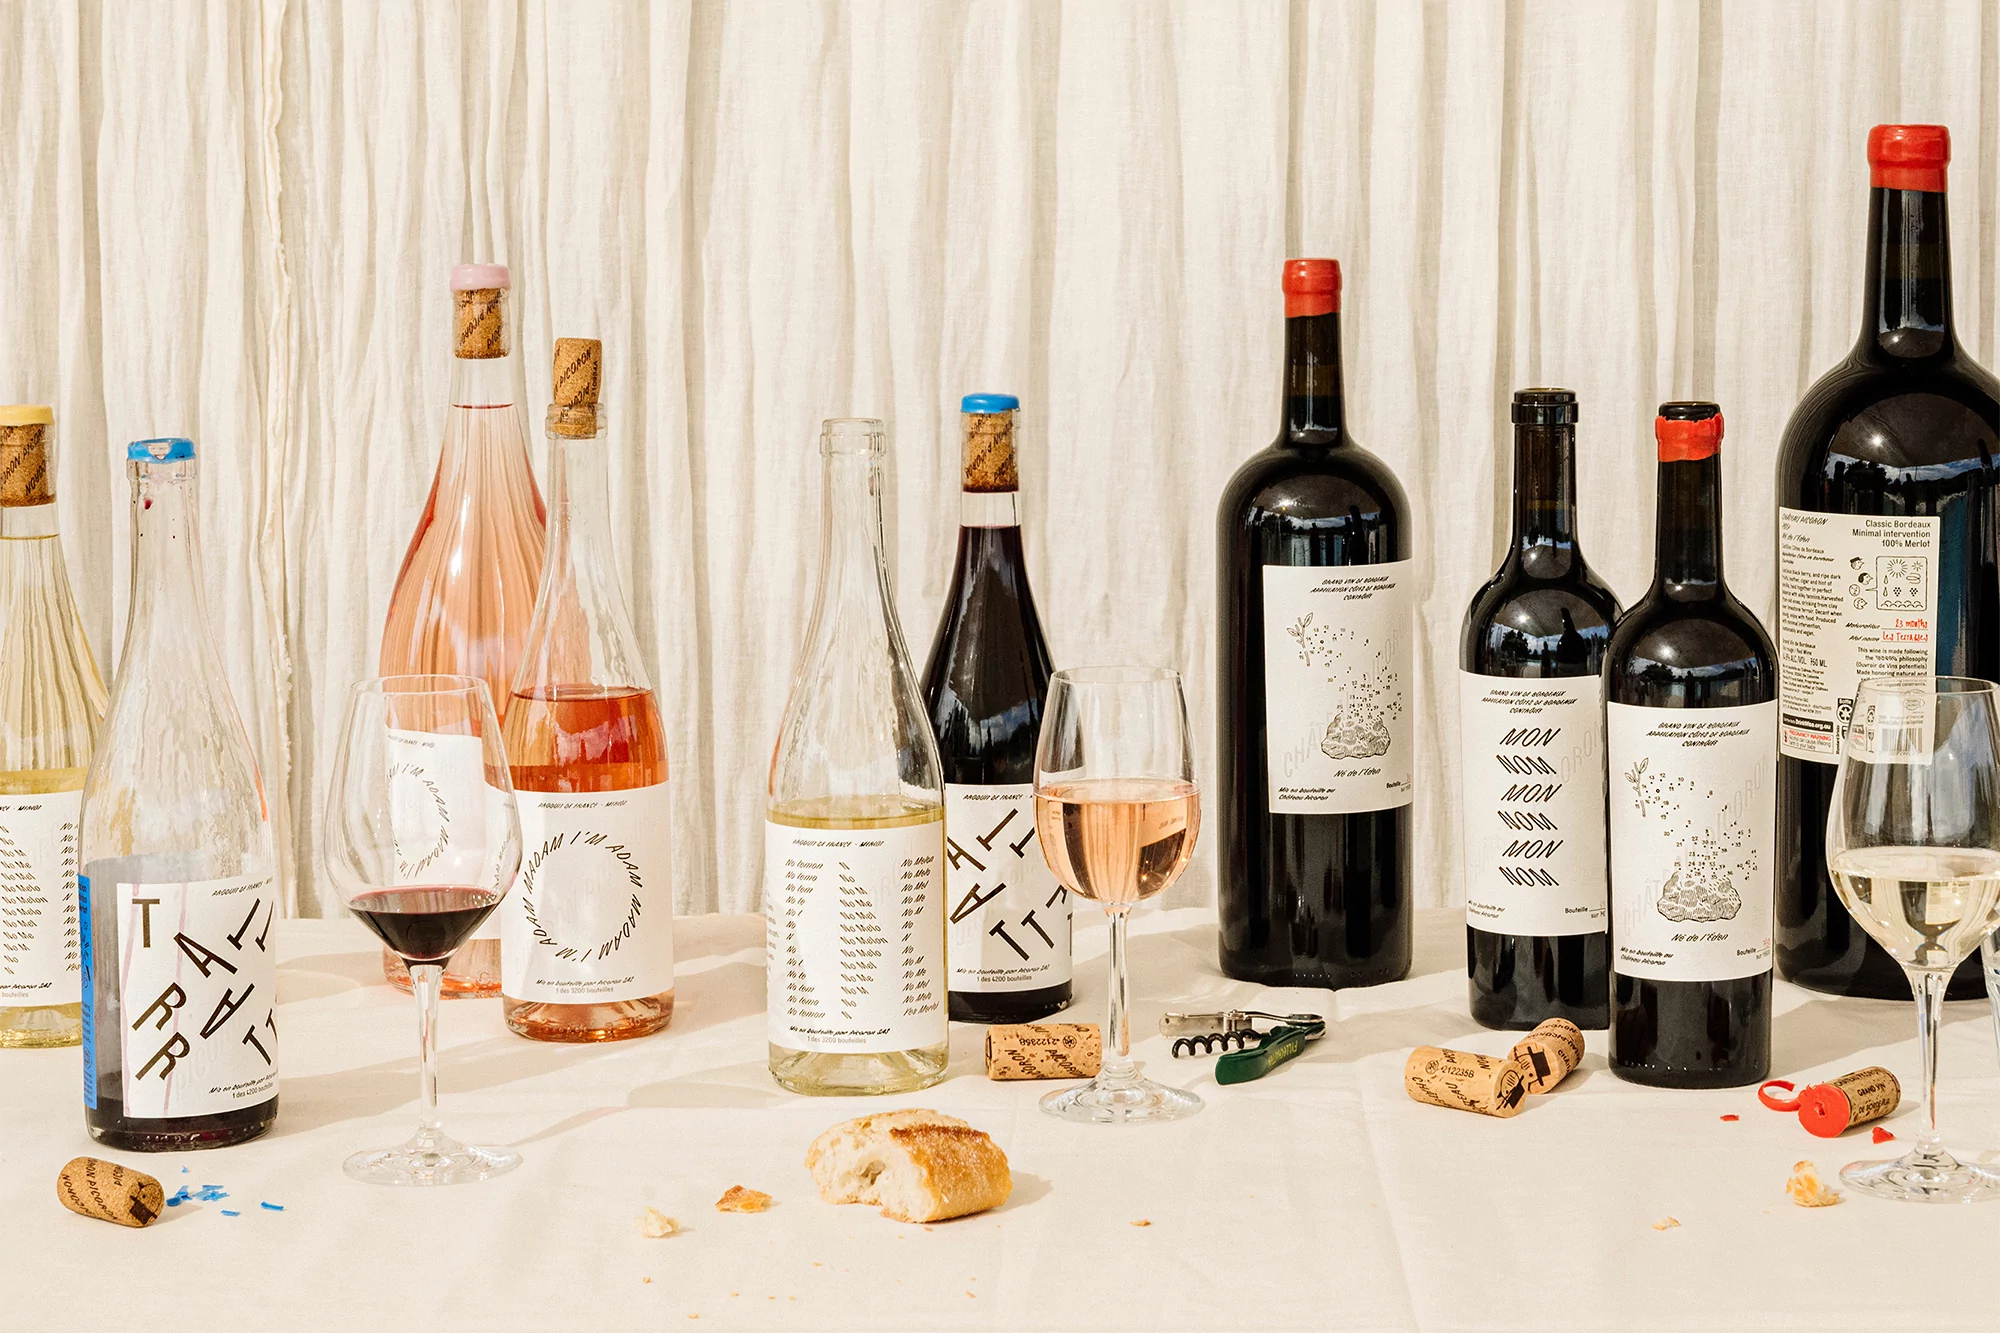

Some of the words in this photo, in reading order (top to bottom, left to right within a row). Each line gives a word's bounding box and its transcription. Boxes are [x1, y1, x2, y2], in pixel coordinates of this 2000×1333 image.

[1865, 519, 1892, 528] Classic
[1894, 520, 1931, 528] Bordeaux
[1852, 528, 1882, 537] Minimal
[1883, 529, 1931, 538] intervention
[1881, 539, 1903, 548] 100%
[1904, 539, 1931, 548] Merlot
[1905, 618, 1928, 629] months
[1882, 631, 1894, 641] Les
[1904, 648, 1928, 656] following
[1898, 663, 1928, 671] potentiels)
[1531, 690, 1566, 698] BORDEAUX
[1543, 698, 1578, 706] BORDEAUX
[1706, 720, 1741, 730] BORDEAUX
[1499, 727, 1561, 747] MON
[1718, 728, 1751, 738] BORDEAUX
[1495, 754, 1557, 775] NOM
[1333, 769, 1348, 778] Né
[1347, 769, 1358, 777] de
[1500, 783, 1562, 803] MON
[1496, 810, 1558, 831] NOM
[569, 829, 608, 846] I'M
[1502, 839, 1564, 859] MON
[522, 831, 565, 895] MADAM
[605, 844, 643, 888] ADAM
[900, 858, 912, 868] No
[839, 874, 856, 883] No
[1498, 866, 1560, 887] NOM
[840, 886, 856, 896] No
[854, 887, 868, 895] M
[840, 899, 856, 908] No
[855, 900, 873, 908] Me
[1564, 906, 1588, 914] Bouteille
[840, 912, 856, 920] No
[855, 911, 877, 920] Mel
[522, 896, 558, 946] ADAM
[598, 893, 642, 961] MADAM
[840, 924, 856, 932] No
[856, 924, 882, 932] Melo
[840, 936, 856, 946] No
[856, 936, 889, 945] Melon
[1670, 934, 1687, 942] Né
[1686, 934, 1699, 942] de
[1699, 932, 1729, 942] l'Éden
[840, 948, 856, 958] No
[856, 948, 882, 957] Melo
[1736, 948, 1756, 956] Bouteille
[840, 961, 857, 970] No
[856, 961, 878, 970] Mel
[840, 974, 857, 982] No
[856, 974, 874, 982] Me
[1006, 974, 1032, 982] bouteilles
[586, 986, 614, 994] bouteilles
[840, 986, 857, 995] No
[856, 986, 870, 994] M
[841, 998, 857, 1008] No
[1857, 1084, 1877, 1097] GRAND
